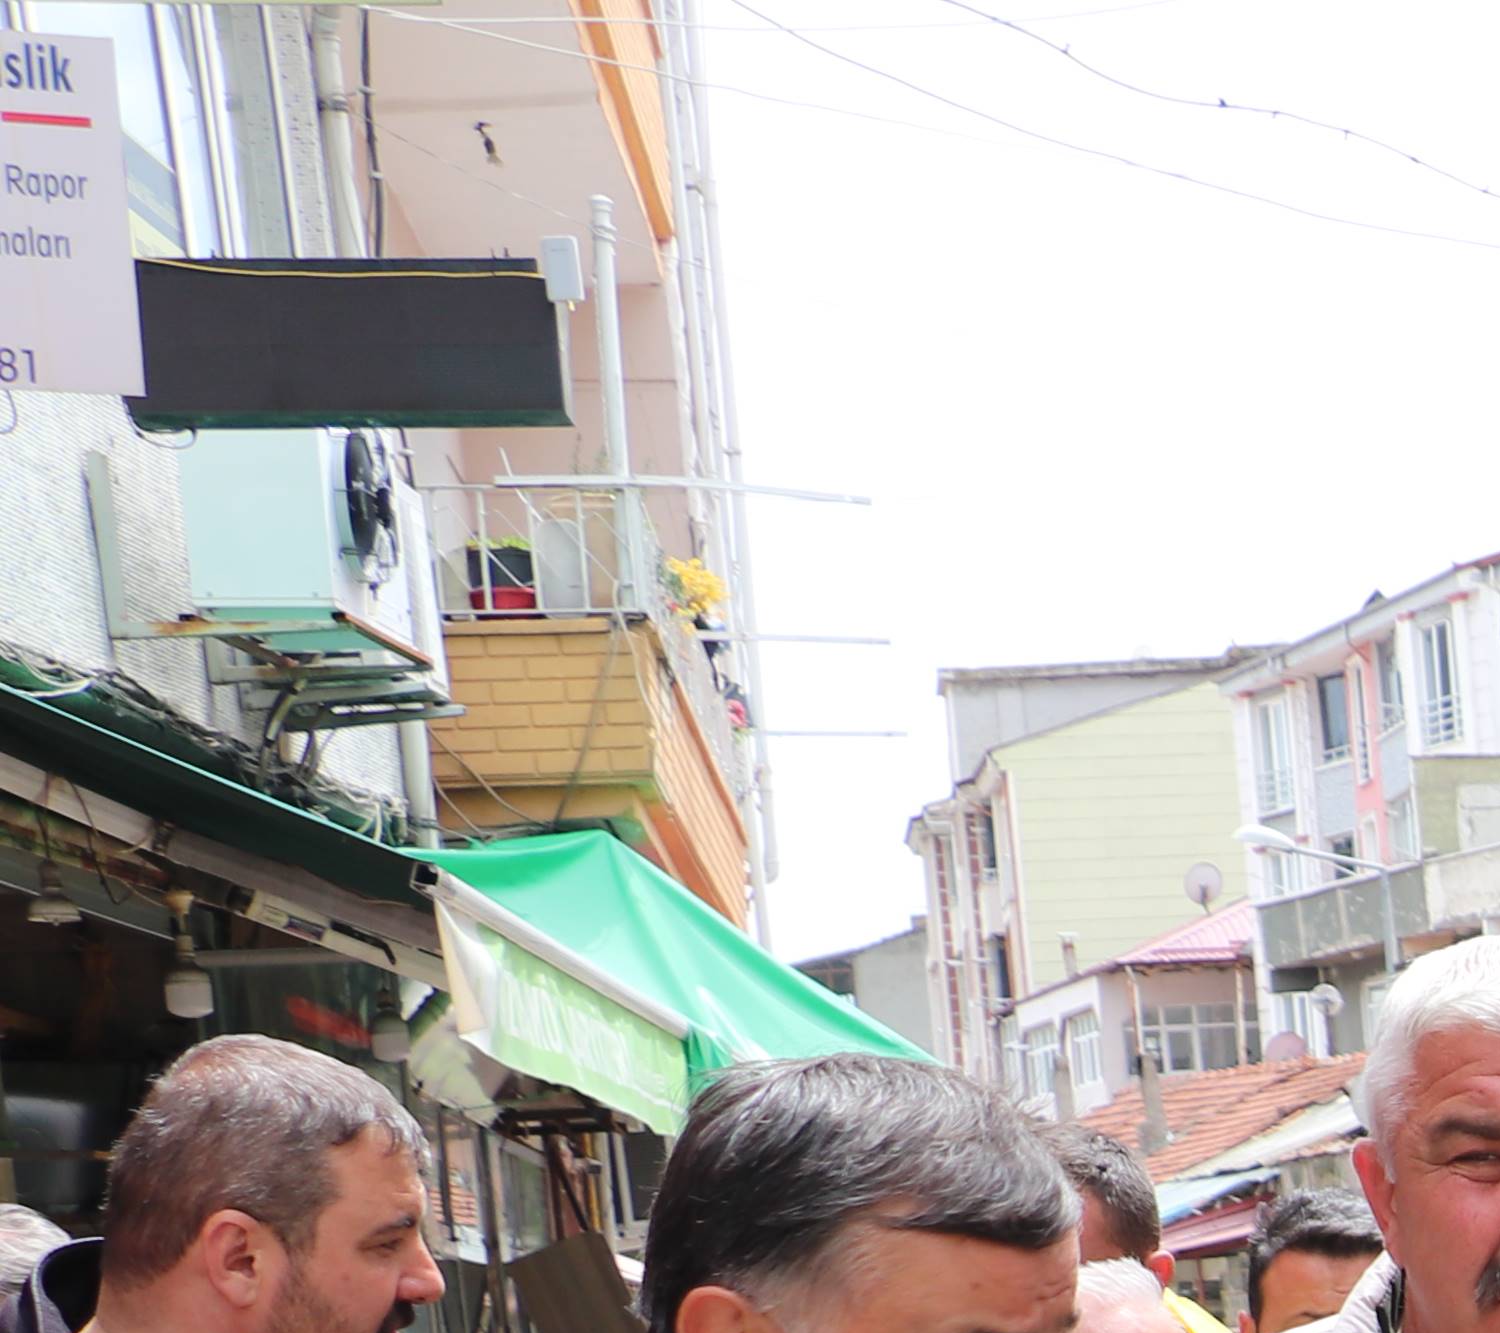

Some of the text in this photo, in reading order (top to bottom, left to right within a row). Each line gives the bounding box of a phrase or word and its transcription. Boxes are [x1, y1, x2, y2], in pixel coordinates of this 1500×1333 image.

[0, 41, 74, 93] slik
[5, 164, 88, 203] Rapor
[0, 348, 37, 384] 81
